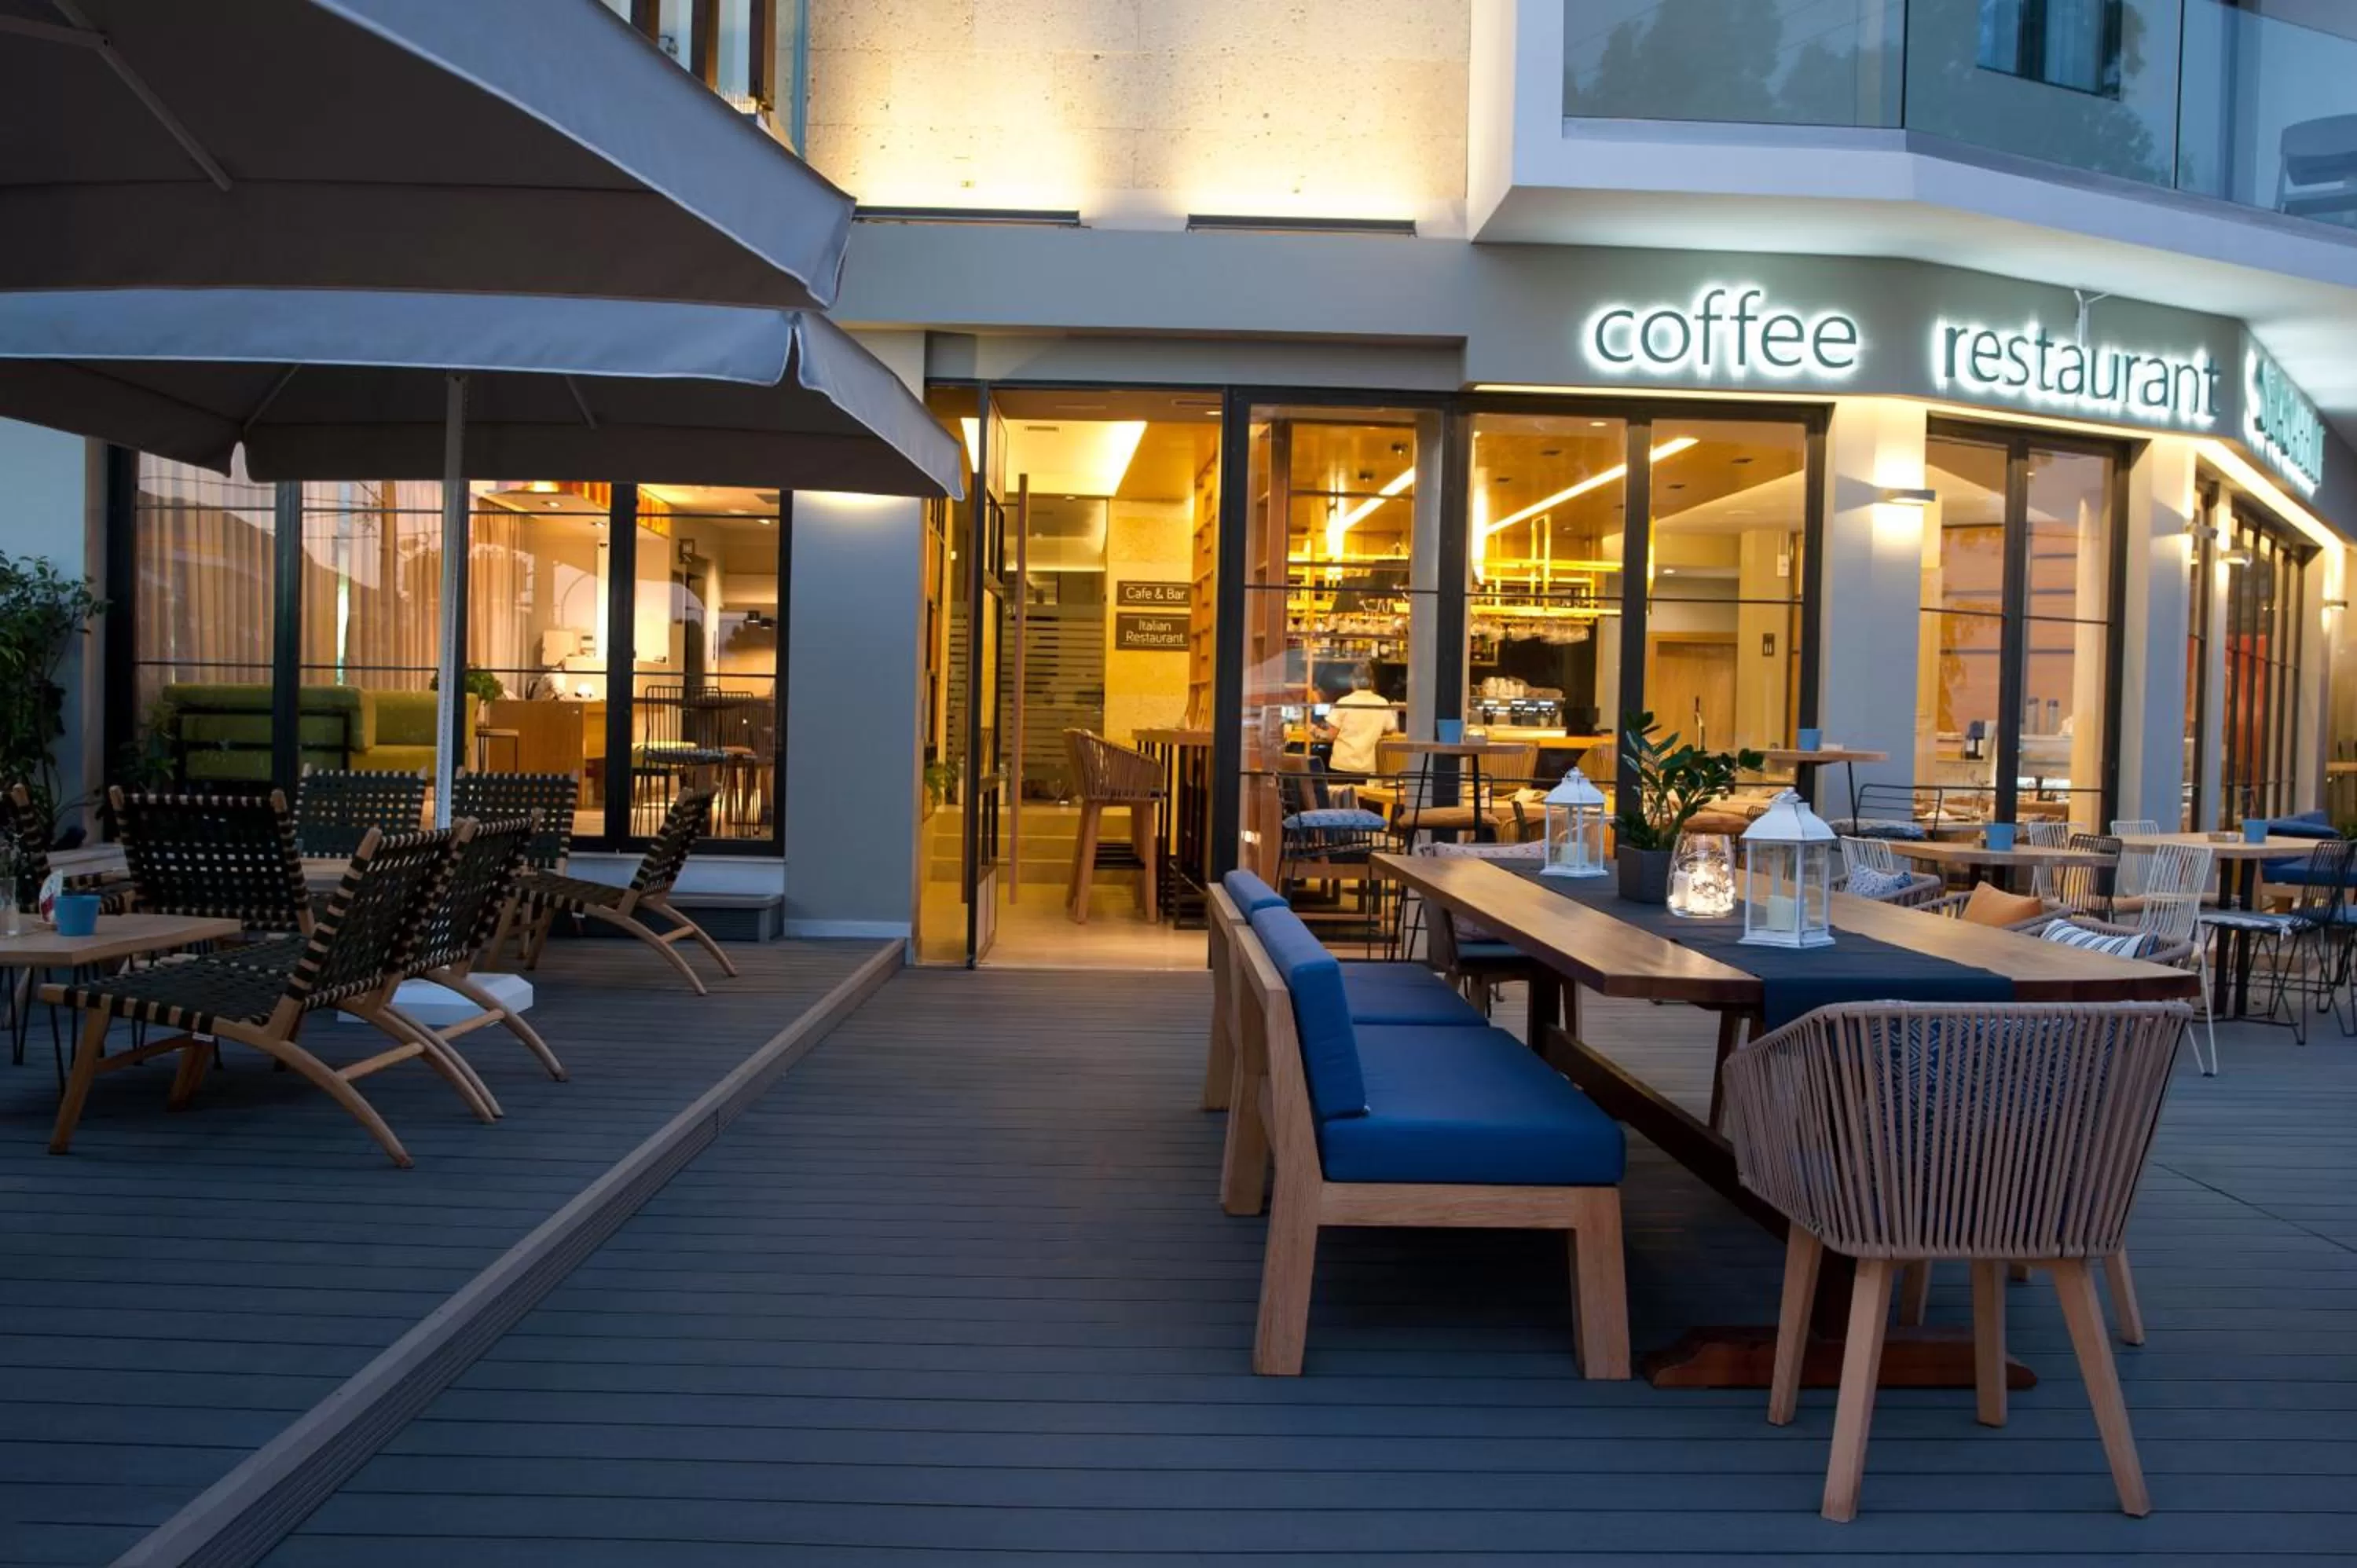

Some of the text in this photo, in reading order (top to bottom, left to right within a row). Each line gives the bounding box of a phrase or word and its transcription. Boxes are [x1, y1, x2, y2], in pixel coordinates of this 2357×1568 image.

[1594, 288, 1857, 368] coffee
[1944, 325, 2222, 416] restaurant
[1126, 587, 1186, 599] Cafe & Bar
[1138, 618, 1171, 632] Italian
[1126, 631, 1184, 644] Restaurant
